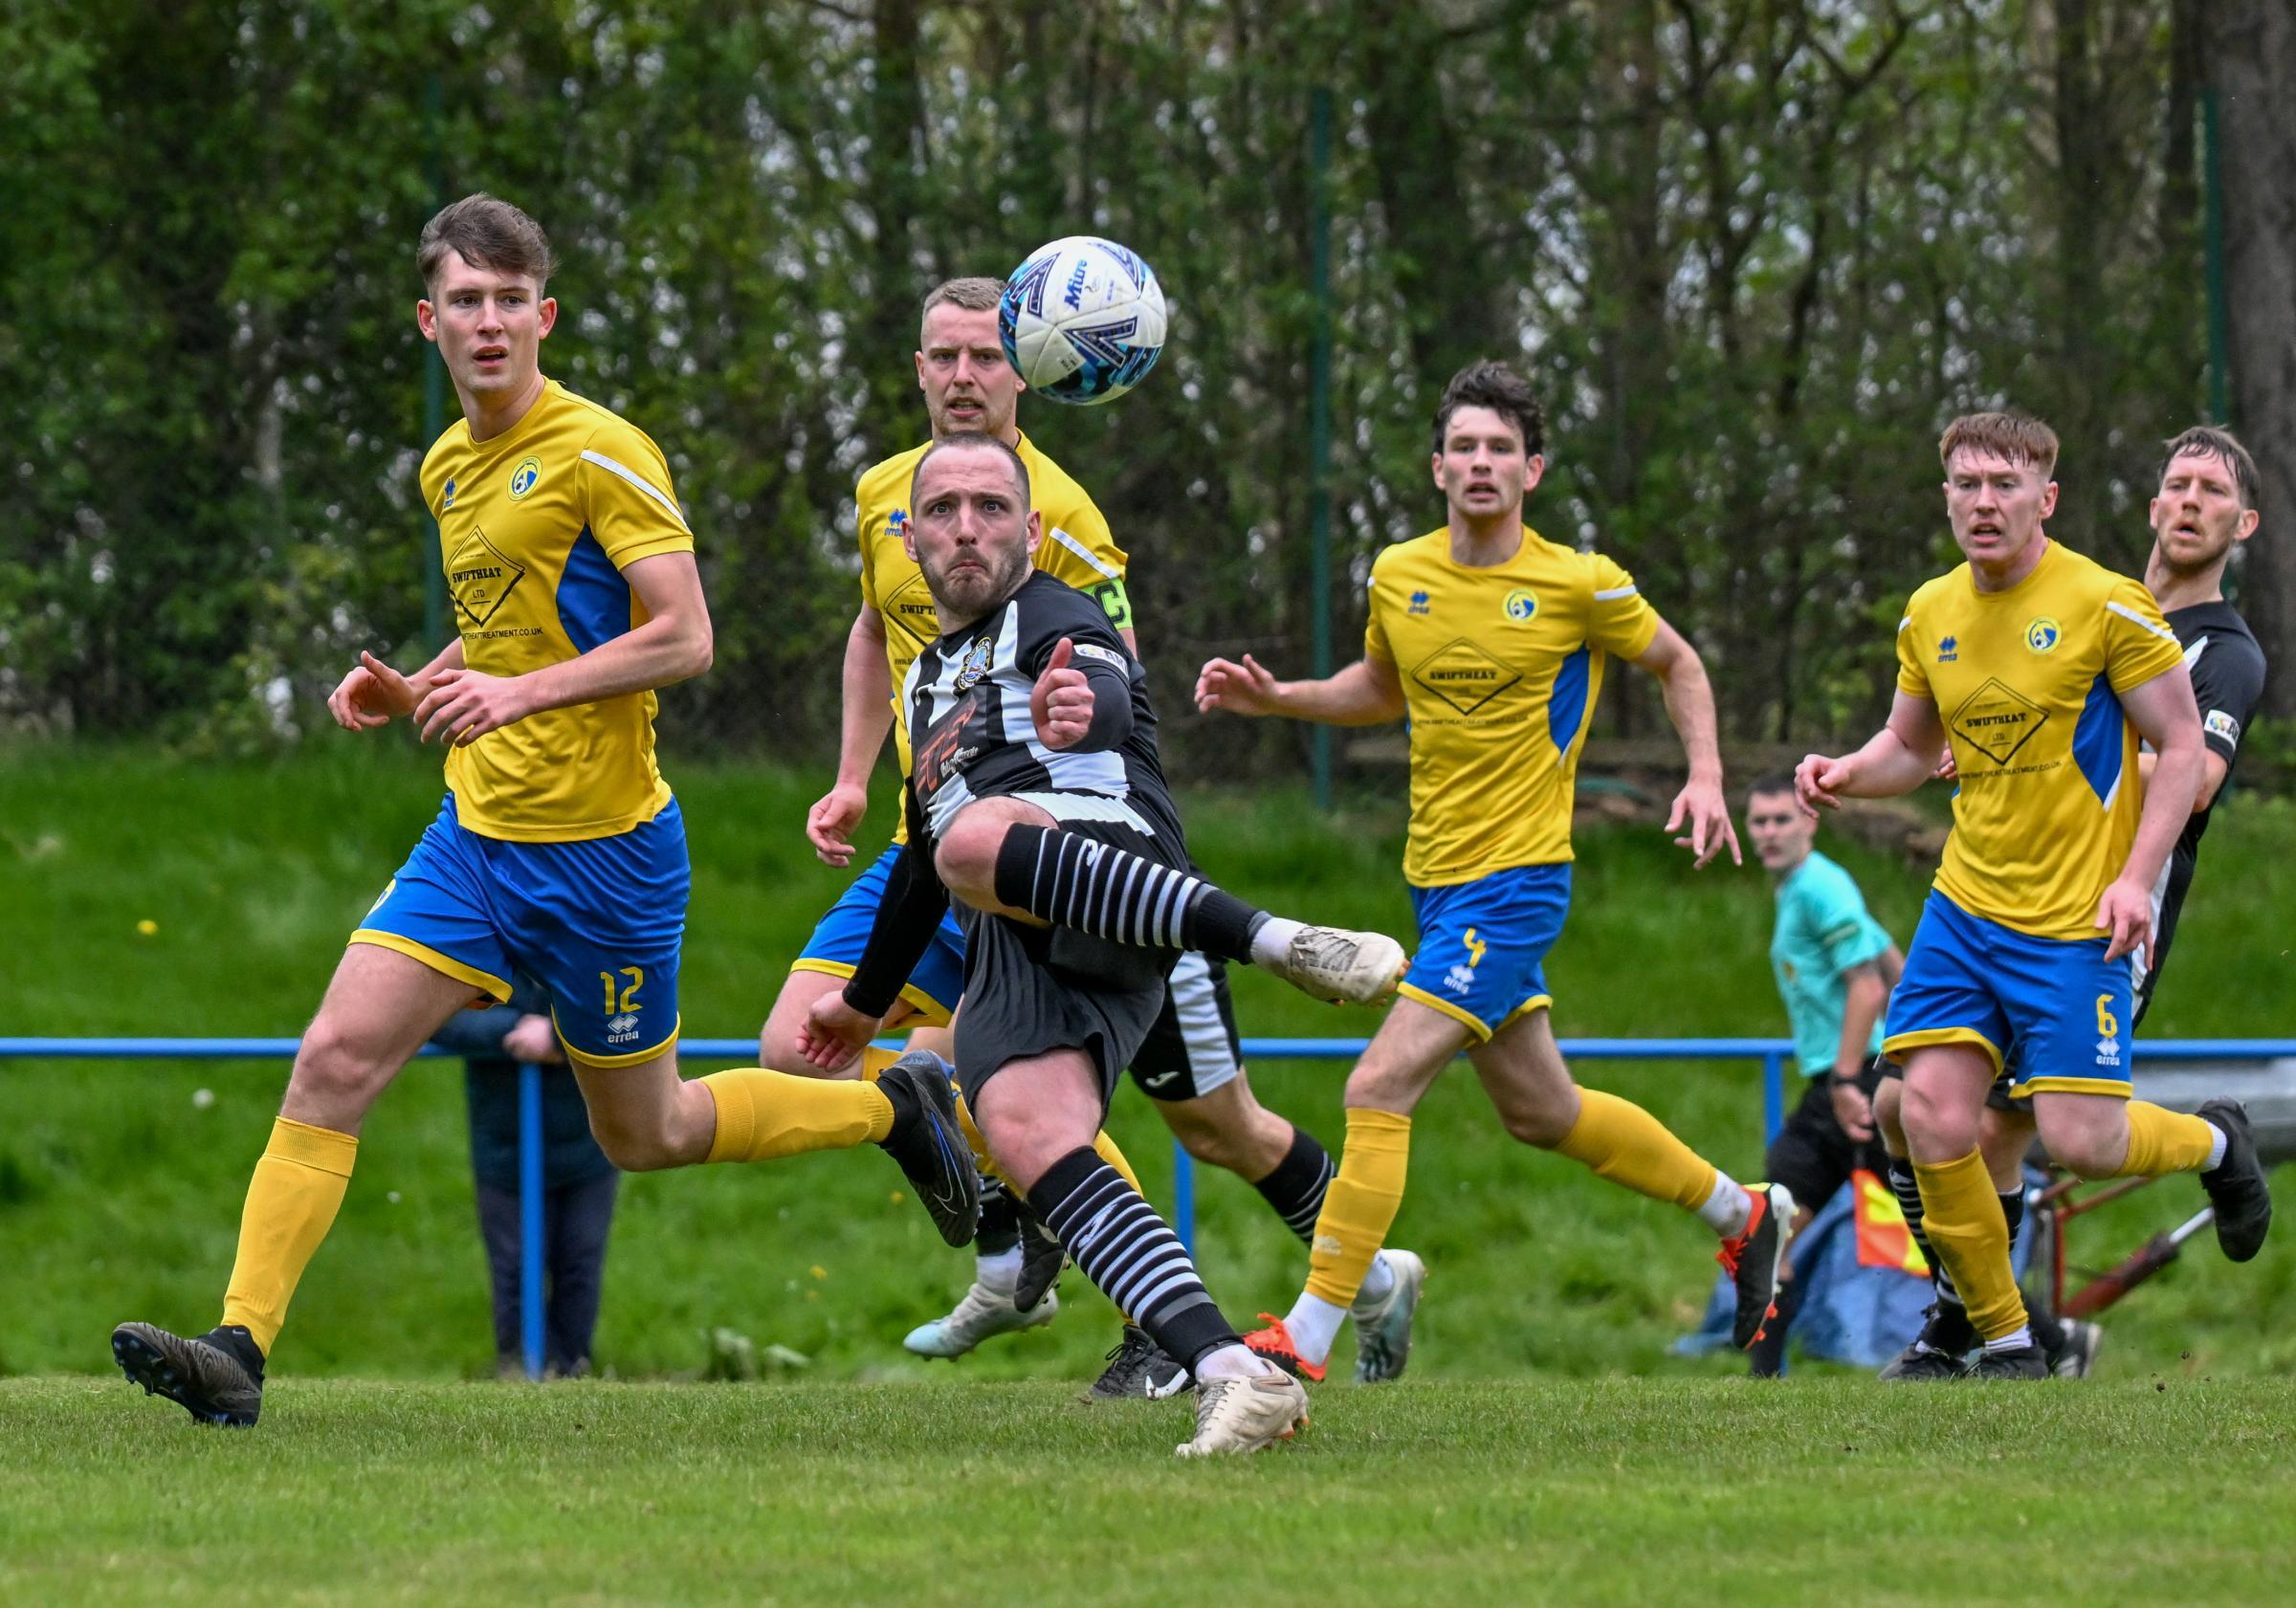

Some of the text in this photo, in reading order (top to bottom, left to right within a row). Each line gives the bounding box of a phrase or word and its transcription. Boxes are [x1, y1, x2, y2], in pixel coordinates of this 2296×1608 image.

[1064, 259, 1087, 311] Mitre
[453, 567, 501, 584] SWIFTHEAT
[472, 589, 486, 599] LTD
[1093, 583, 1125, 624] C
[900, 604, 937, 615] SWIFT
[1429, 671, 1497, 680] SWIFTHEAT
[1966, 712, 2026, 728] SWIFTHEAT
[1464, 927, 1487, 968] 4
[600, 966, 643, 1015] 12
[2096, 994, 2118, 1039] 6
